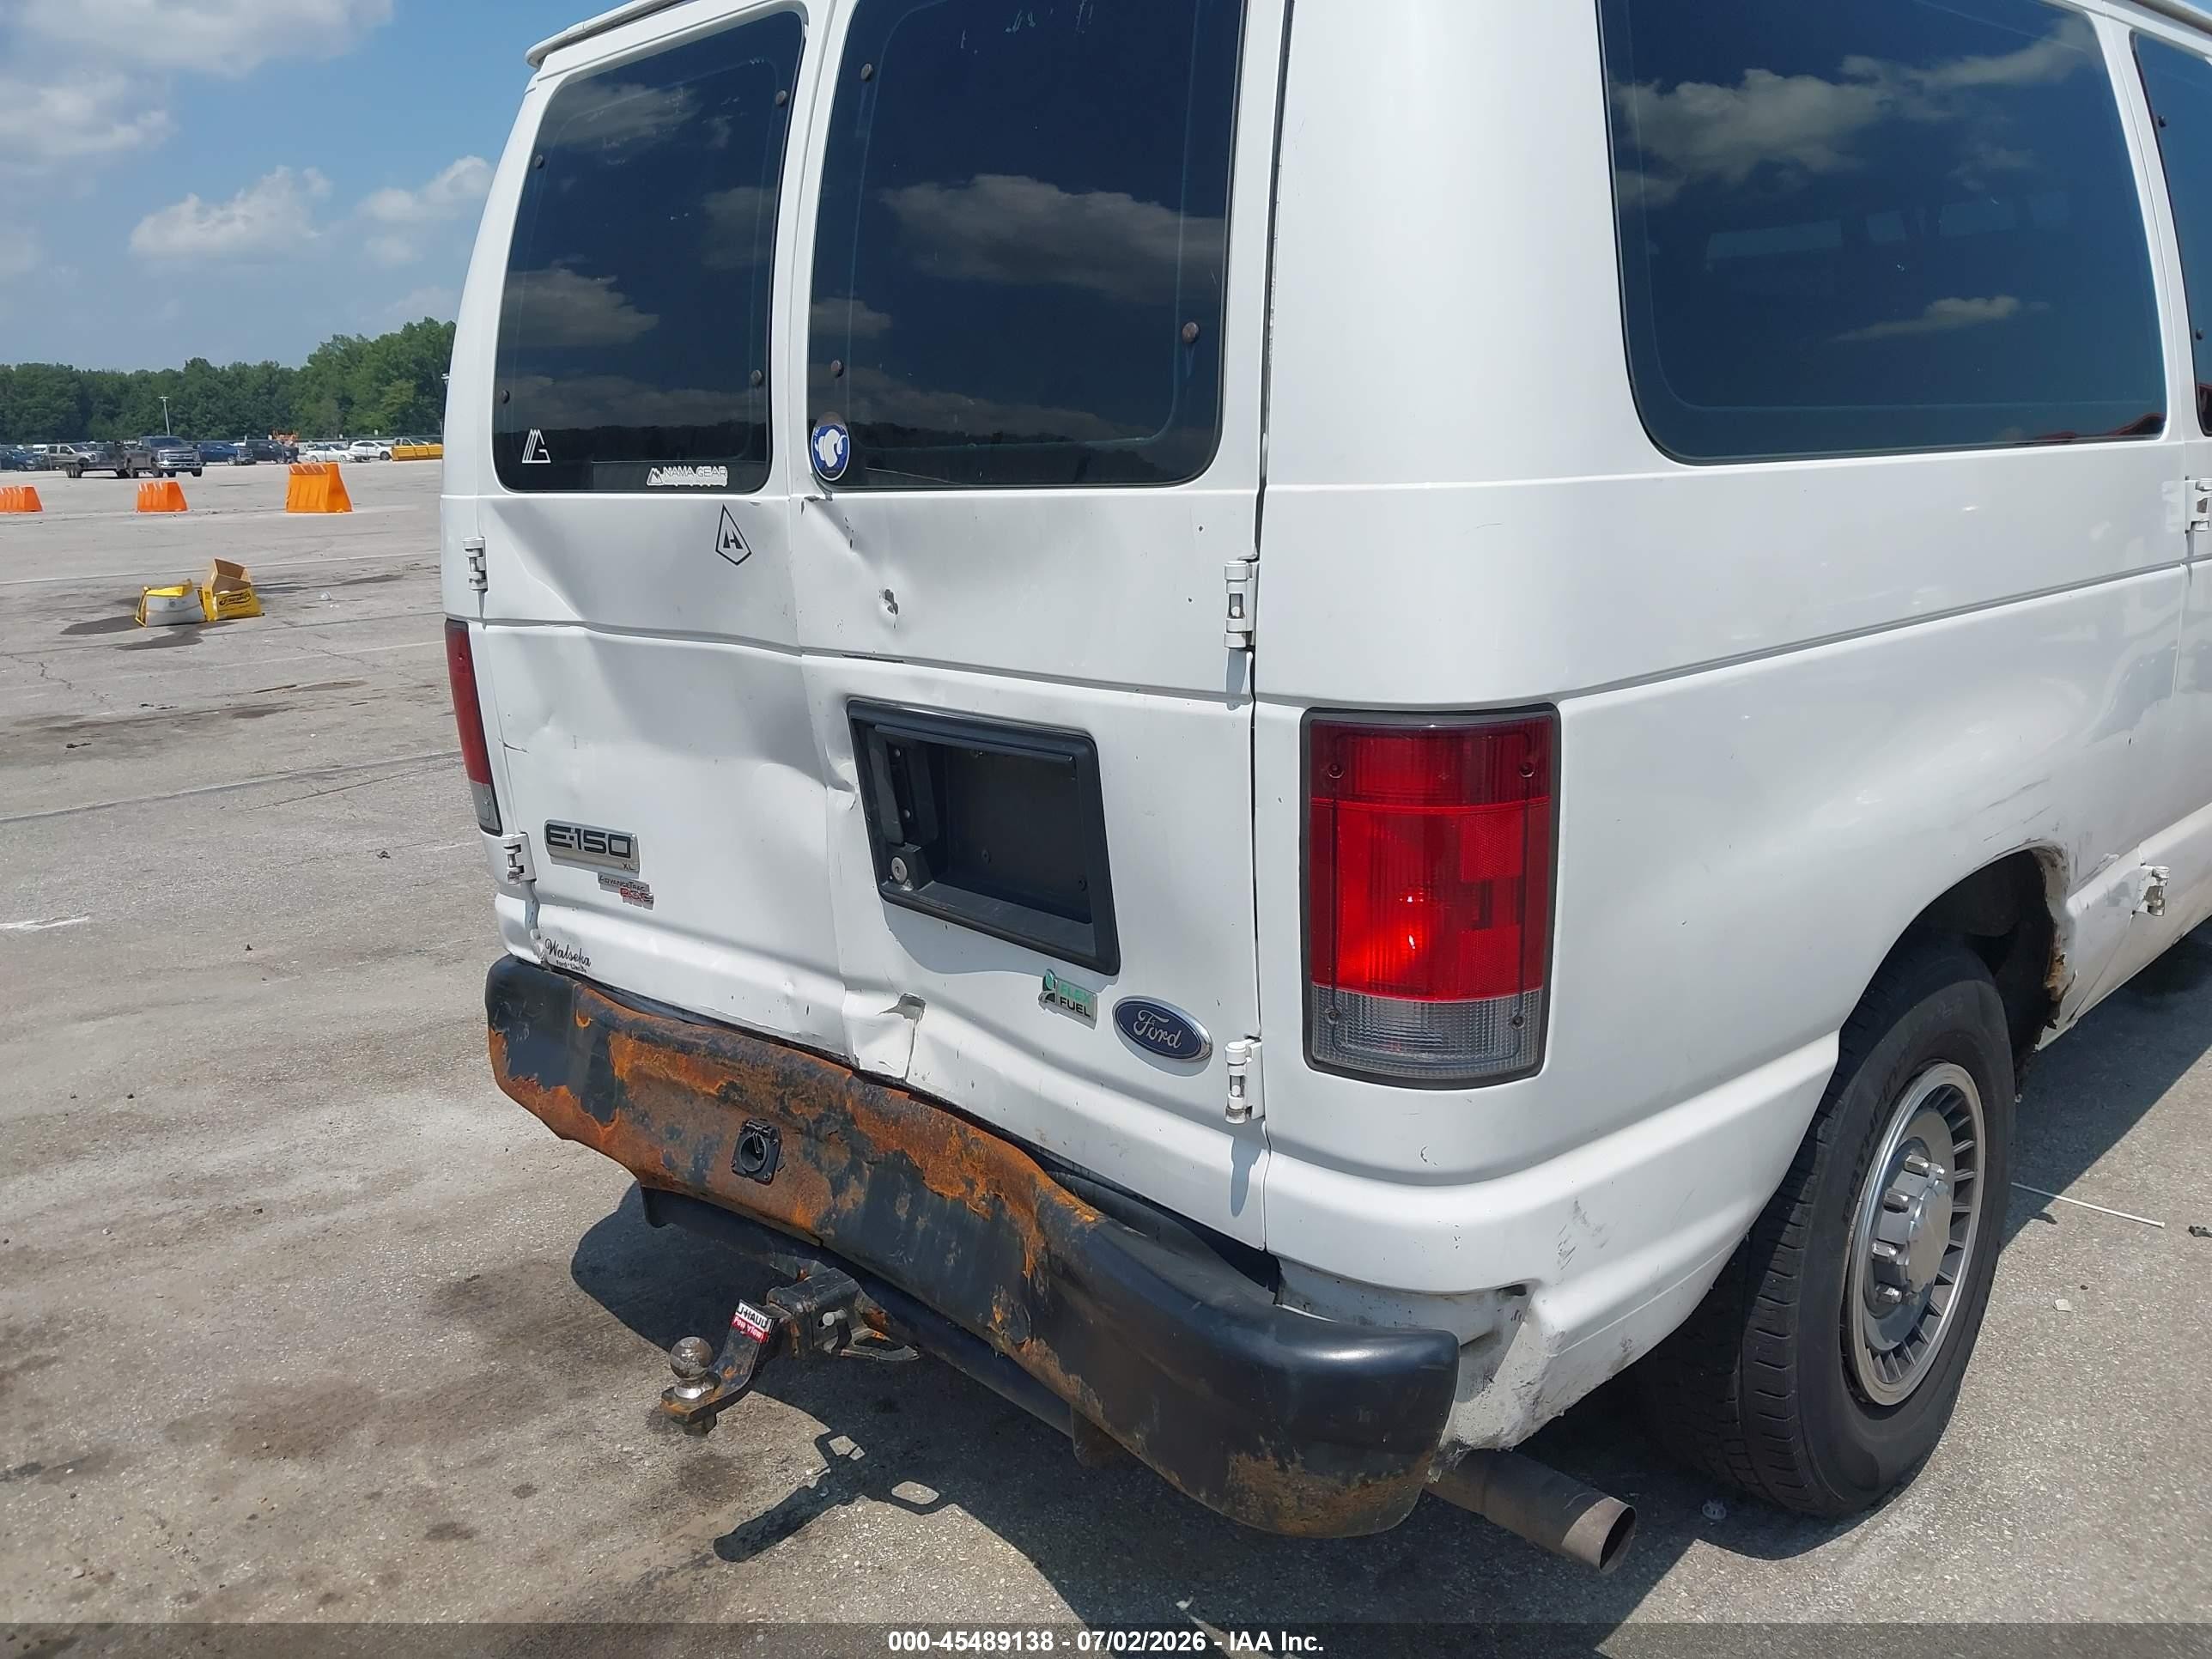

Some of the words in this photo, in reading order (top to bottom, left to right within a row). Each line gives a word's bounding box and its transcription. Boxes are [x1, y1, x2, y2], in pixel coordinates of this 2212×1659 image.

[696, 466, 727, 477] GEAR
[546, 823, 631, 859] E-150
[623, 862, 636, 872] XL
[1060, 983, 1091, 1004] FLEX
[1060, 996, 1091, 1018] FUEL
[1133, 1009, 1182, 1049] Ford
